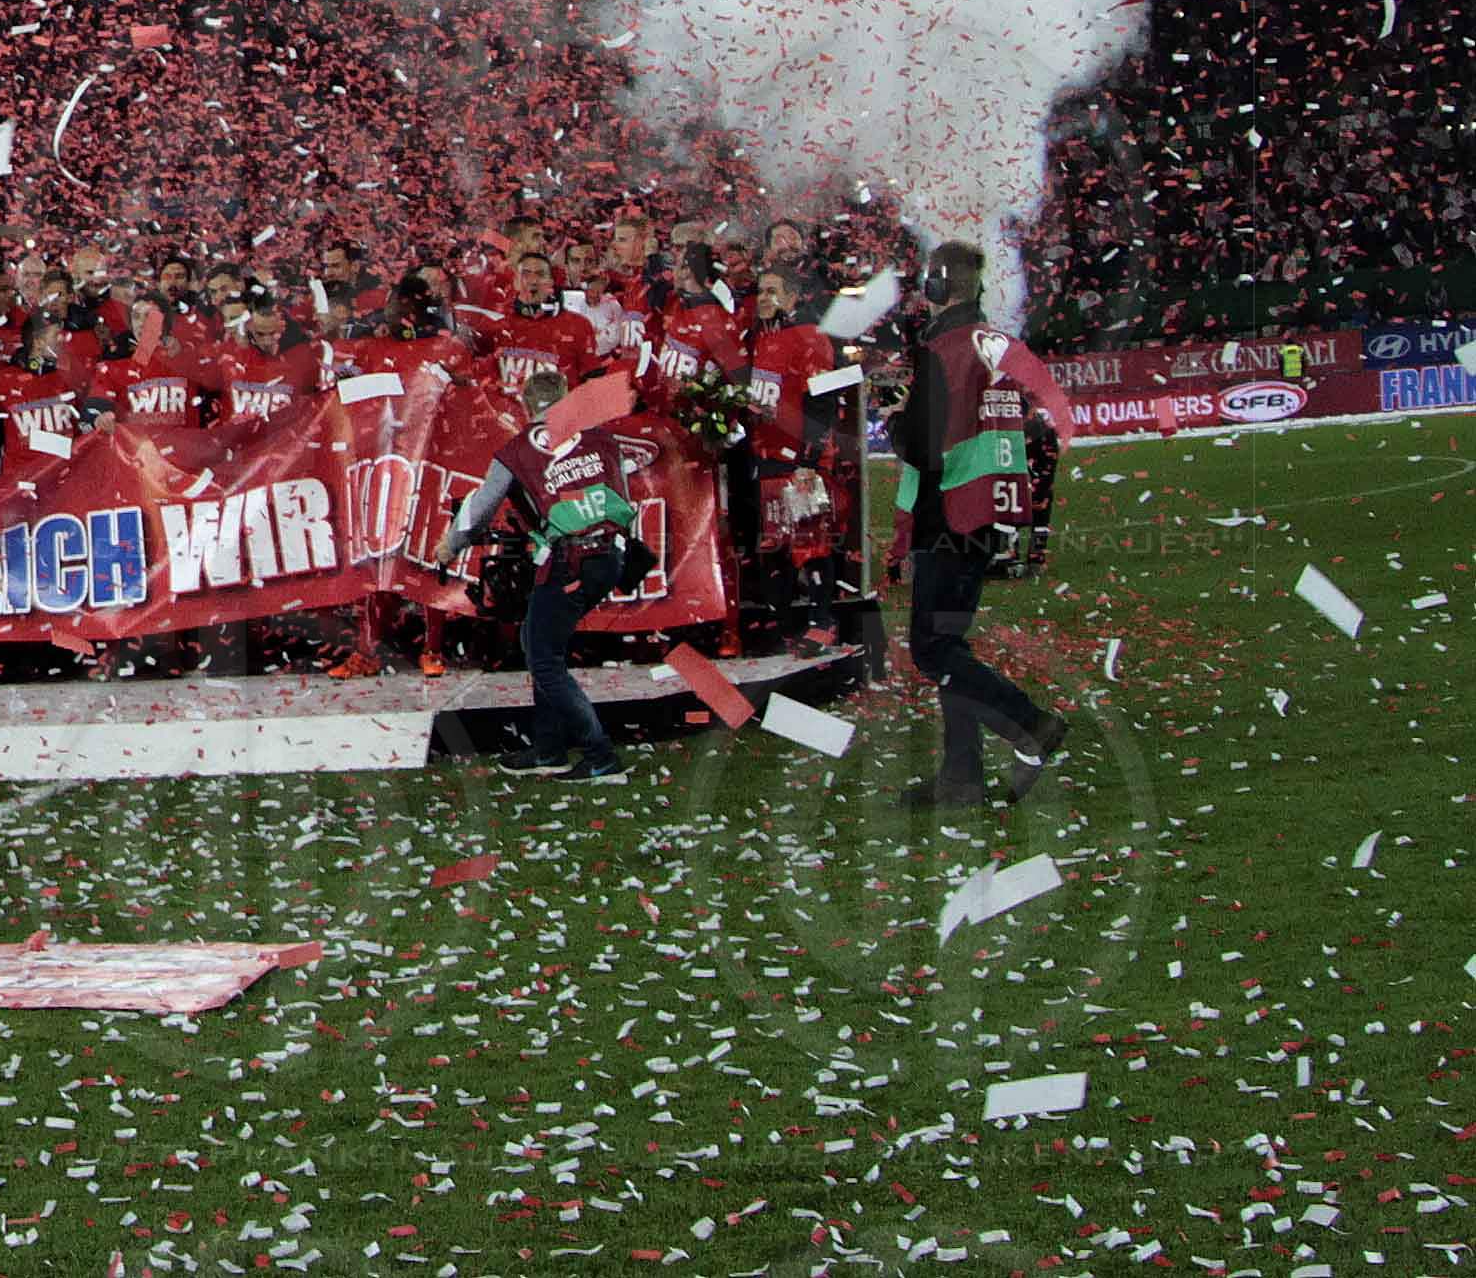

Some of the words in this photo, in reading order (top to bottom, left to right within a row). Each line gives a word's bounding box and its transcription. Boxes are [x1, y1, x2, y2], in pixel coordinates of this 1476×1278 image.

[1211, 339, 1336, 373] GENEALI
[129, 385, 188, 414] WIR
[993, 480, 1024, 514] 51
[161, 478, 335, 593] WIR
